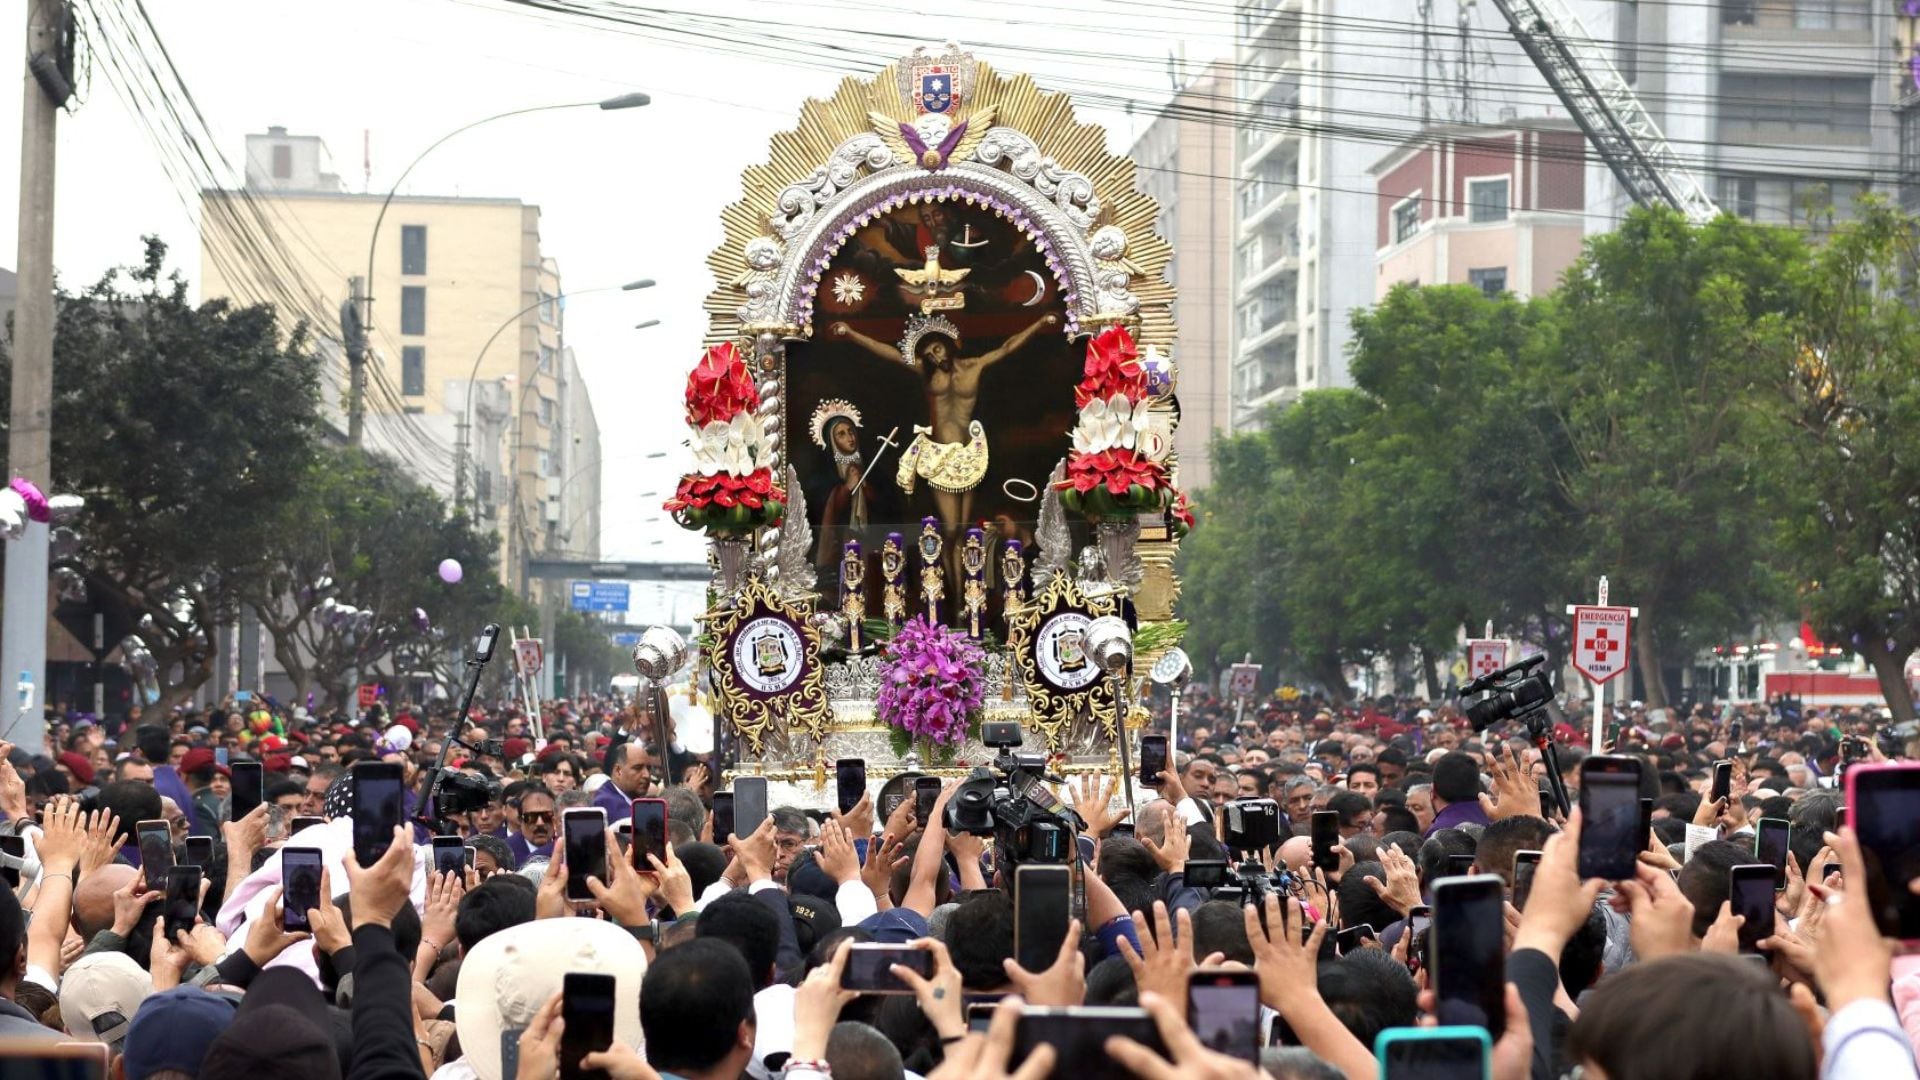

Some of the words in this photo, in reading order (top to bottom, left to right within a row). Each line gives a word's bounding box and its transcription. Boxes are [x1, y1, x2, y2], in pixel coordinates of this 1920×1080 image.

[1580, 611, 1625, 622] EMERGENCIA
[1596, 639, 1607, 649] 16
[1588, 663, 1612, 672] HSMN
[1263, 805, 1275, 816] 16
[795, 905, 816, 919] 1924
